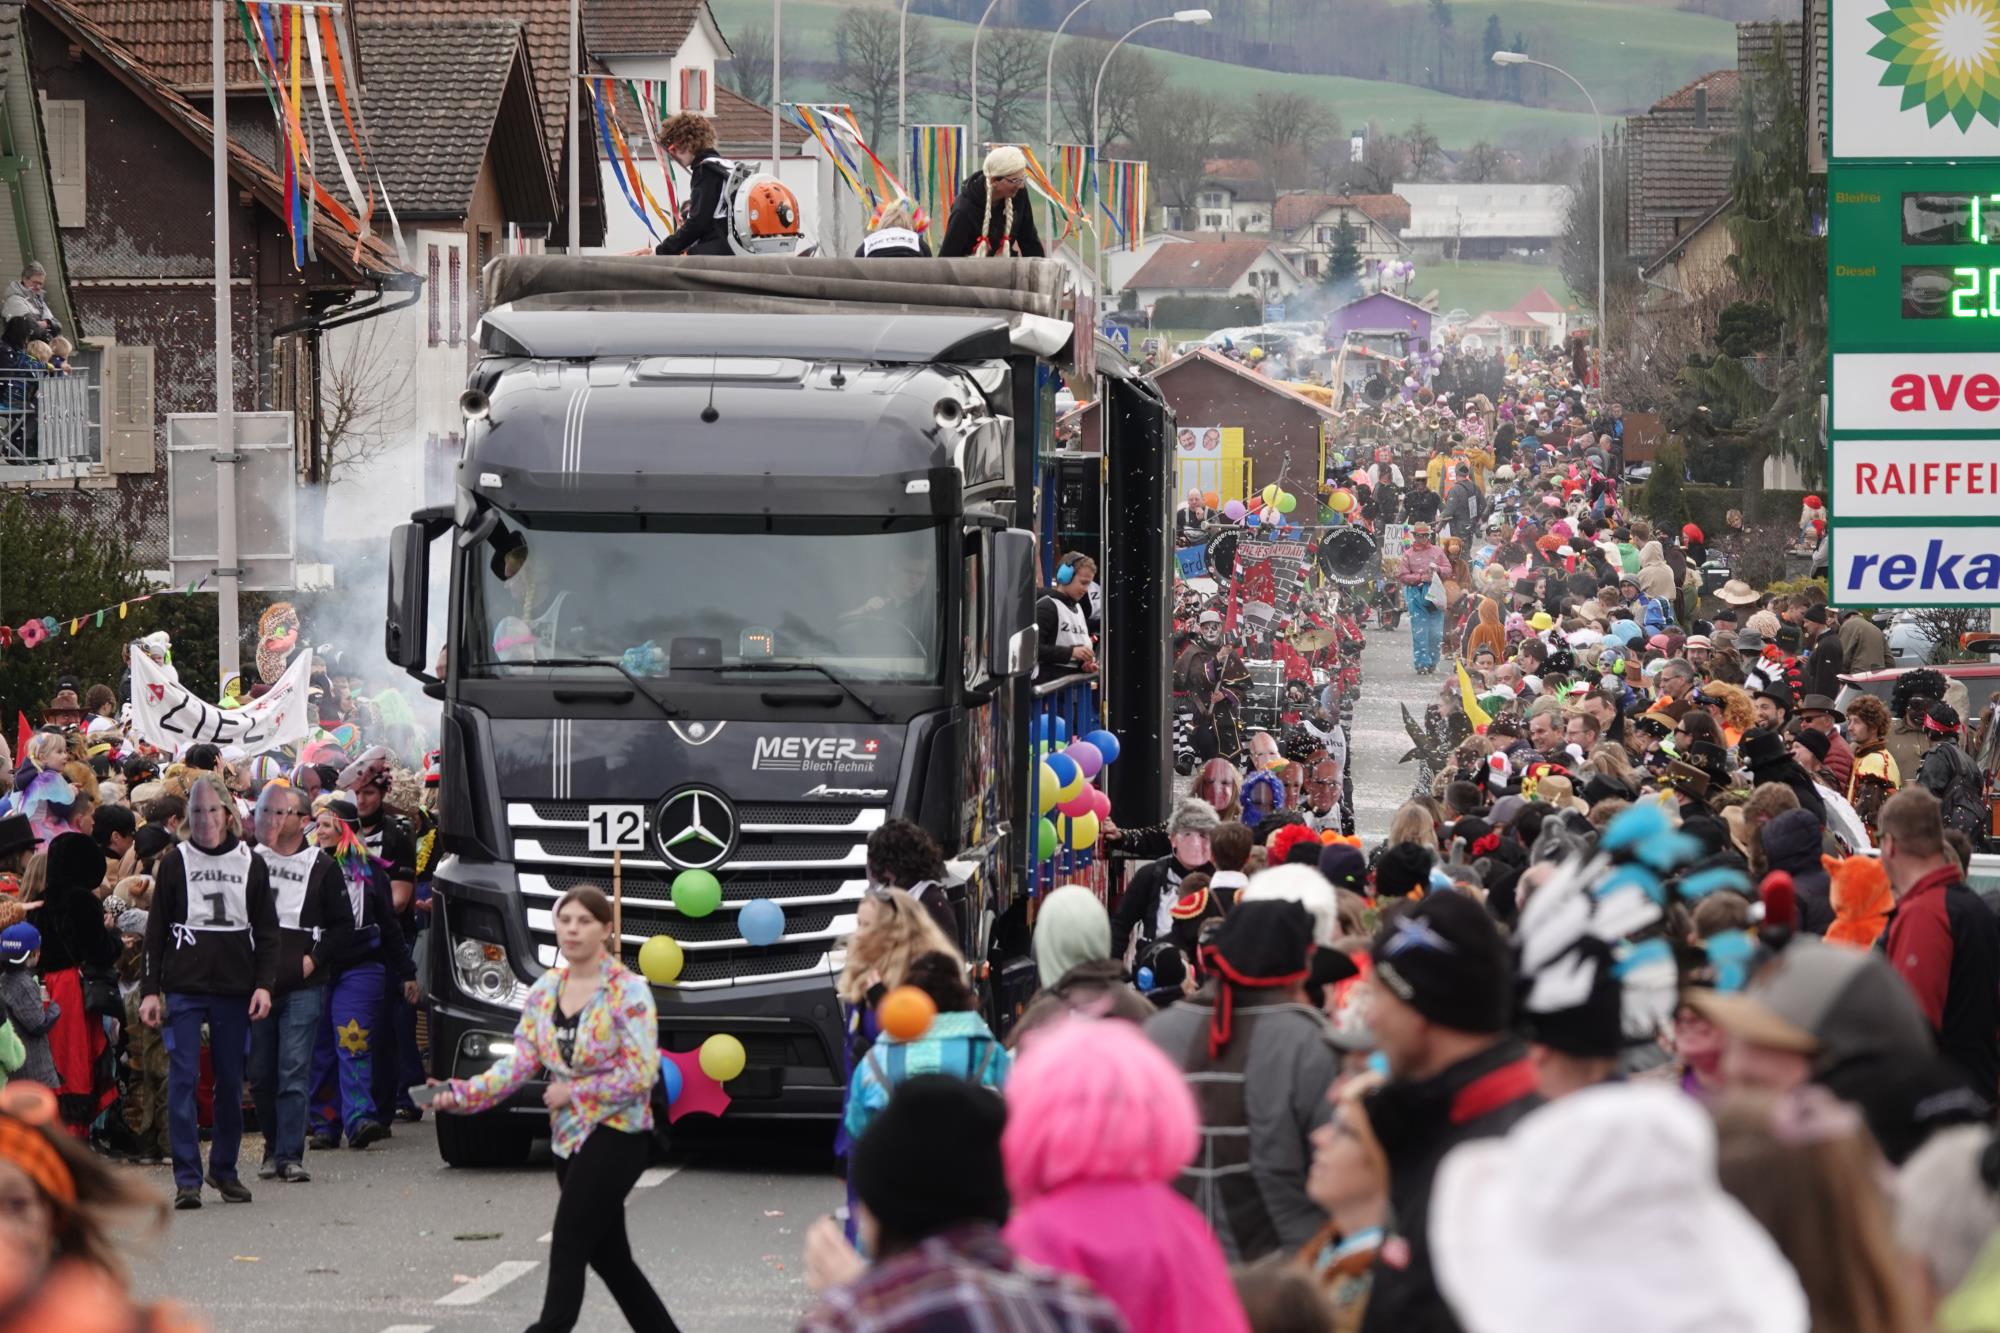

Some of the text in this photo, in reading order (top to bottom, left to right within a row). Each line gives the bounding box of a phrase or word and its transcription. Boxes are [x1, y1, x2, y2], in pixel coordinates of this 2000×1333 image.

[1836, 192, 1881, 203] Bleifrei
[1836, 265, 1877, 277] Diesel
[1890, 373, 2000, 412] ave
[1856, 463, 1997, 494] RAIFFEI
[1182, 552, 1203, 574] erd
[1847, 539, 2000, 591] reka
[160, 682, 264, 744] ZIEL
[752, 736, 877, 770] MEYER
[802, 760, 875, 772] BlechTechnik
[593, 811, 640, 844] 12
[190, 869, 243, 884] Züku
[267, 865, 304, 883] üku
[203, 892, 235, 926] 1
